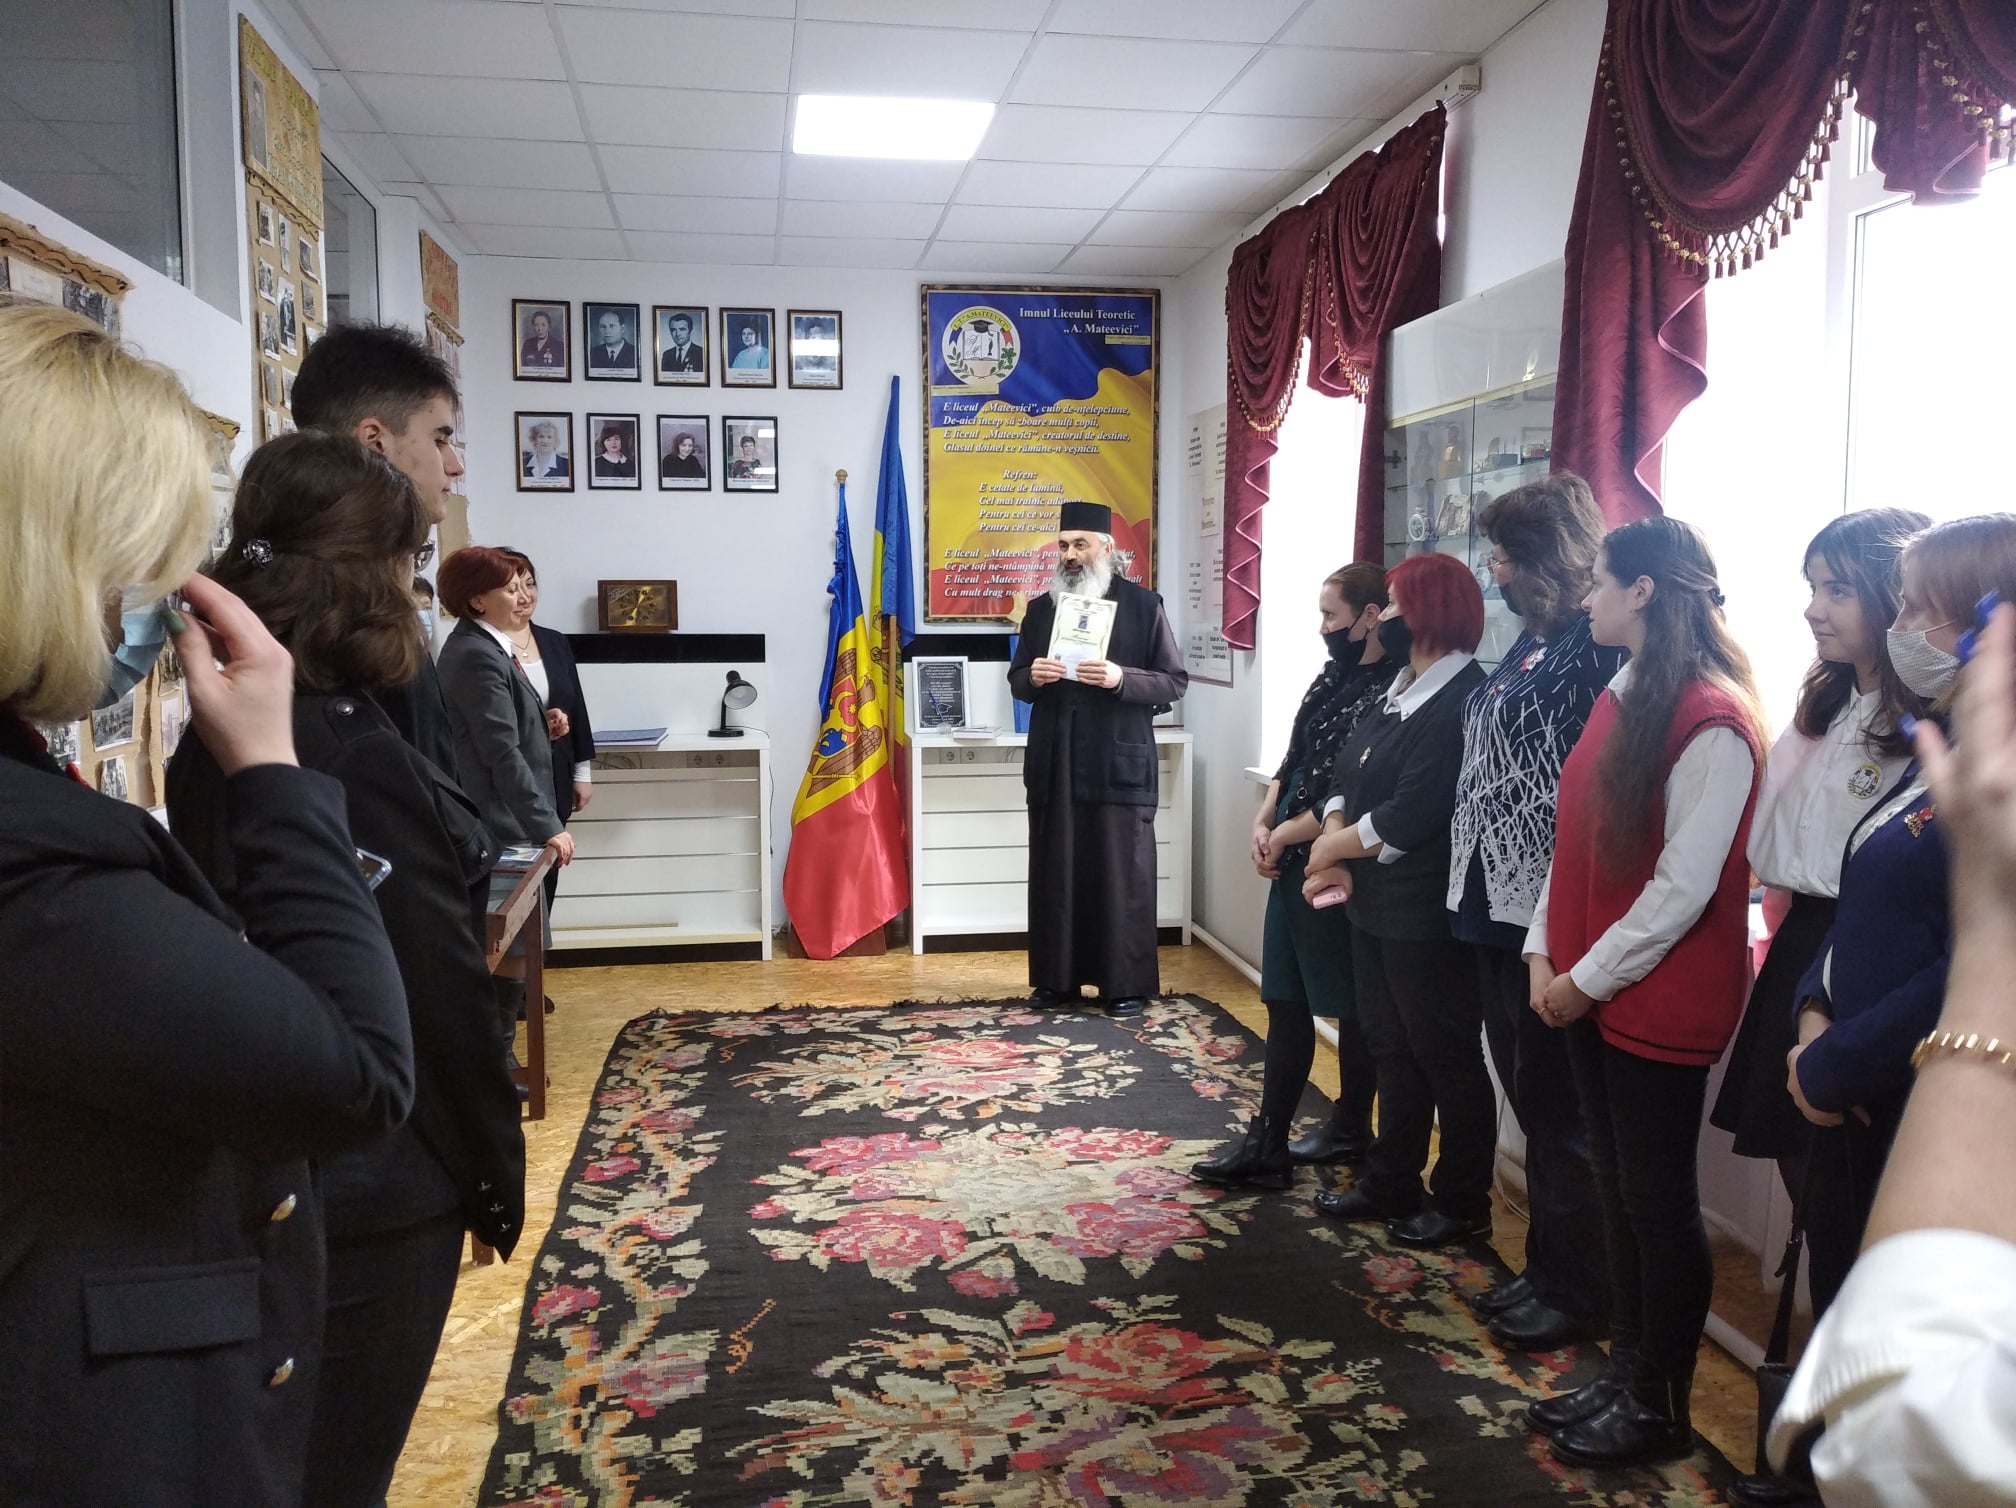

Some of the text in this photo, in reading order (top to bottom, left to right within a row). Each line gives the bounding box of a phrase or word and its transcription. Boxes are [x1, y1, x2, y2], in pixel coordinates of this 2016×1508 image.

[1019, 308, 1136, 320] Imnul Liceului Teoretic
[943, 402, 951, 412] E
[953, 402, 979, 412] liceul
[1041, 403, 1061, 413] cuib
[943, 415, 976, 425] De-aici
[978, 417, 1003, 428] încep
[1005, 417, 1015, 426] să
[1017, 417, 1047, 427] zboare
[1074, 418, 1099, 429] copii,
[943, 429, 951, 439] E
[953, 429, 979, 439] liceul
[1041, 430, 1083, 440] creatorul
[1084, 431, 1095, 440] de
[1097, 431, 1130, 442] destine,
[943, 442, 974, 452] Glasul
[975, 443, 1004, 452] doinei
[1003, 469, 1037, 481] Refren:
[979, 483, 1064, 494] E cetate de lumină,
[979, 496, 995, 505] Cel
[996, 497, 1014, 506] mai
[1015, 497, 1045, 506] trainic
[979, 509, 1010, 519] Pentru
[1011, 510, 1025, 519] cei
[1027, 511, 1037, 519] ce
[1039, 511, 1054, 519] vor
[979, 522, 1057, 532] Pentru cei ce-aici
[944, 548, 952, 558] E
[954, 548, 979, 558] liceul
[944, 561, 958, 571] Ce
[958, 563, 970, 572] pe
[944, 574, 952, 584] E
[954, 574, 980, 584] liceul
[944, 587, 958, 597] Cu
[960, 588, 981, 597] mult
[982, 587, 1003, 598] drag
